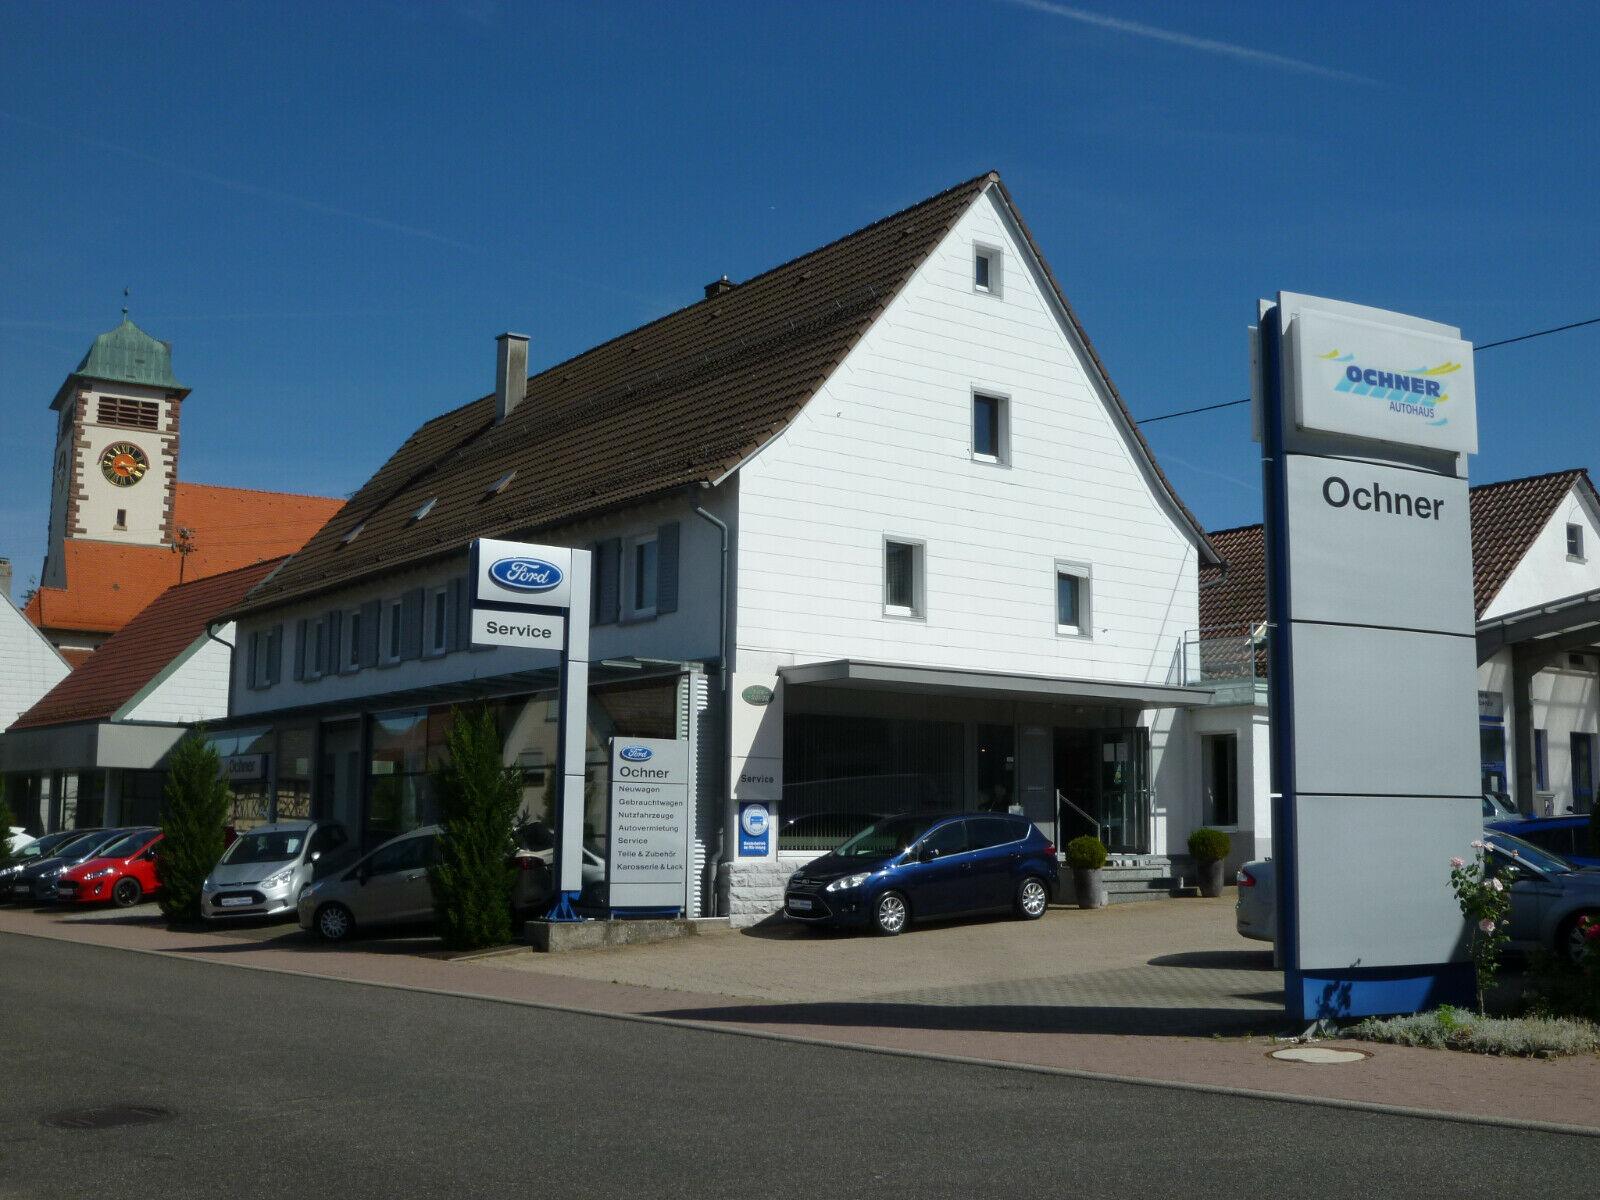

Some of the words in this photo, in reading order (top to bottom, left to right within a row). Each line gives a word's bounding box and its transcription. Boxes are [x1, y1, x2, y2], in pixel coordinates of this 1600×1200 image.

[1346, 365, 1441, 398] OCHNER
[1389, 401, 1435, 418] AUTOHAUS
[1322, 476, 1444, 521] Ochner
[506, 561, 550, 584] Ford
[486, 621, 552, 639] Service
[619, 766, 670, 779] Ochner
[740, 774, 775, 784] Service
[618, 785, 661, 794] Neuwagen
[618, 798, 684, 808] Gebrauchtwagen
[618, 811, 675, 820] Nutzfahrzeuge
[618, 824, 679, 833] Autovermietung
[617, 837, 648, 845] Service
[617, 850, 637, 858] Teile
[645, 850, 677, 858] Zubehör
[616, 863, 659, 871] Karosserie
[666, 863, 684, 871] Lack
